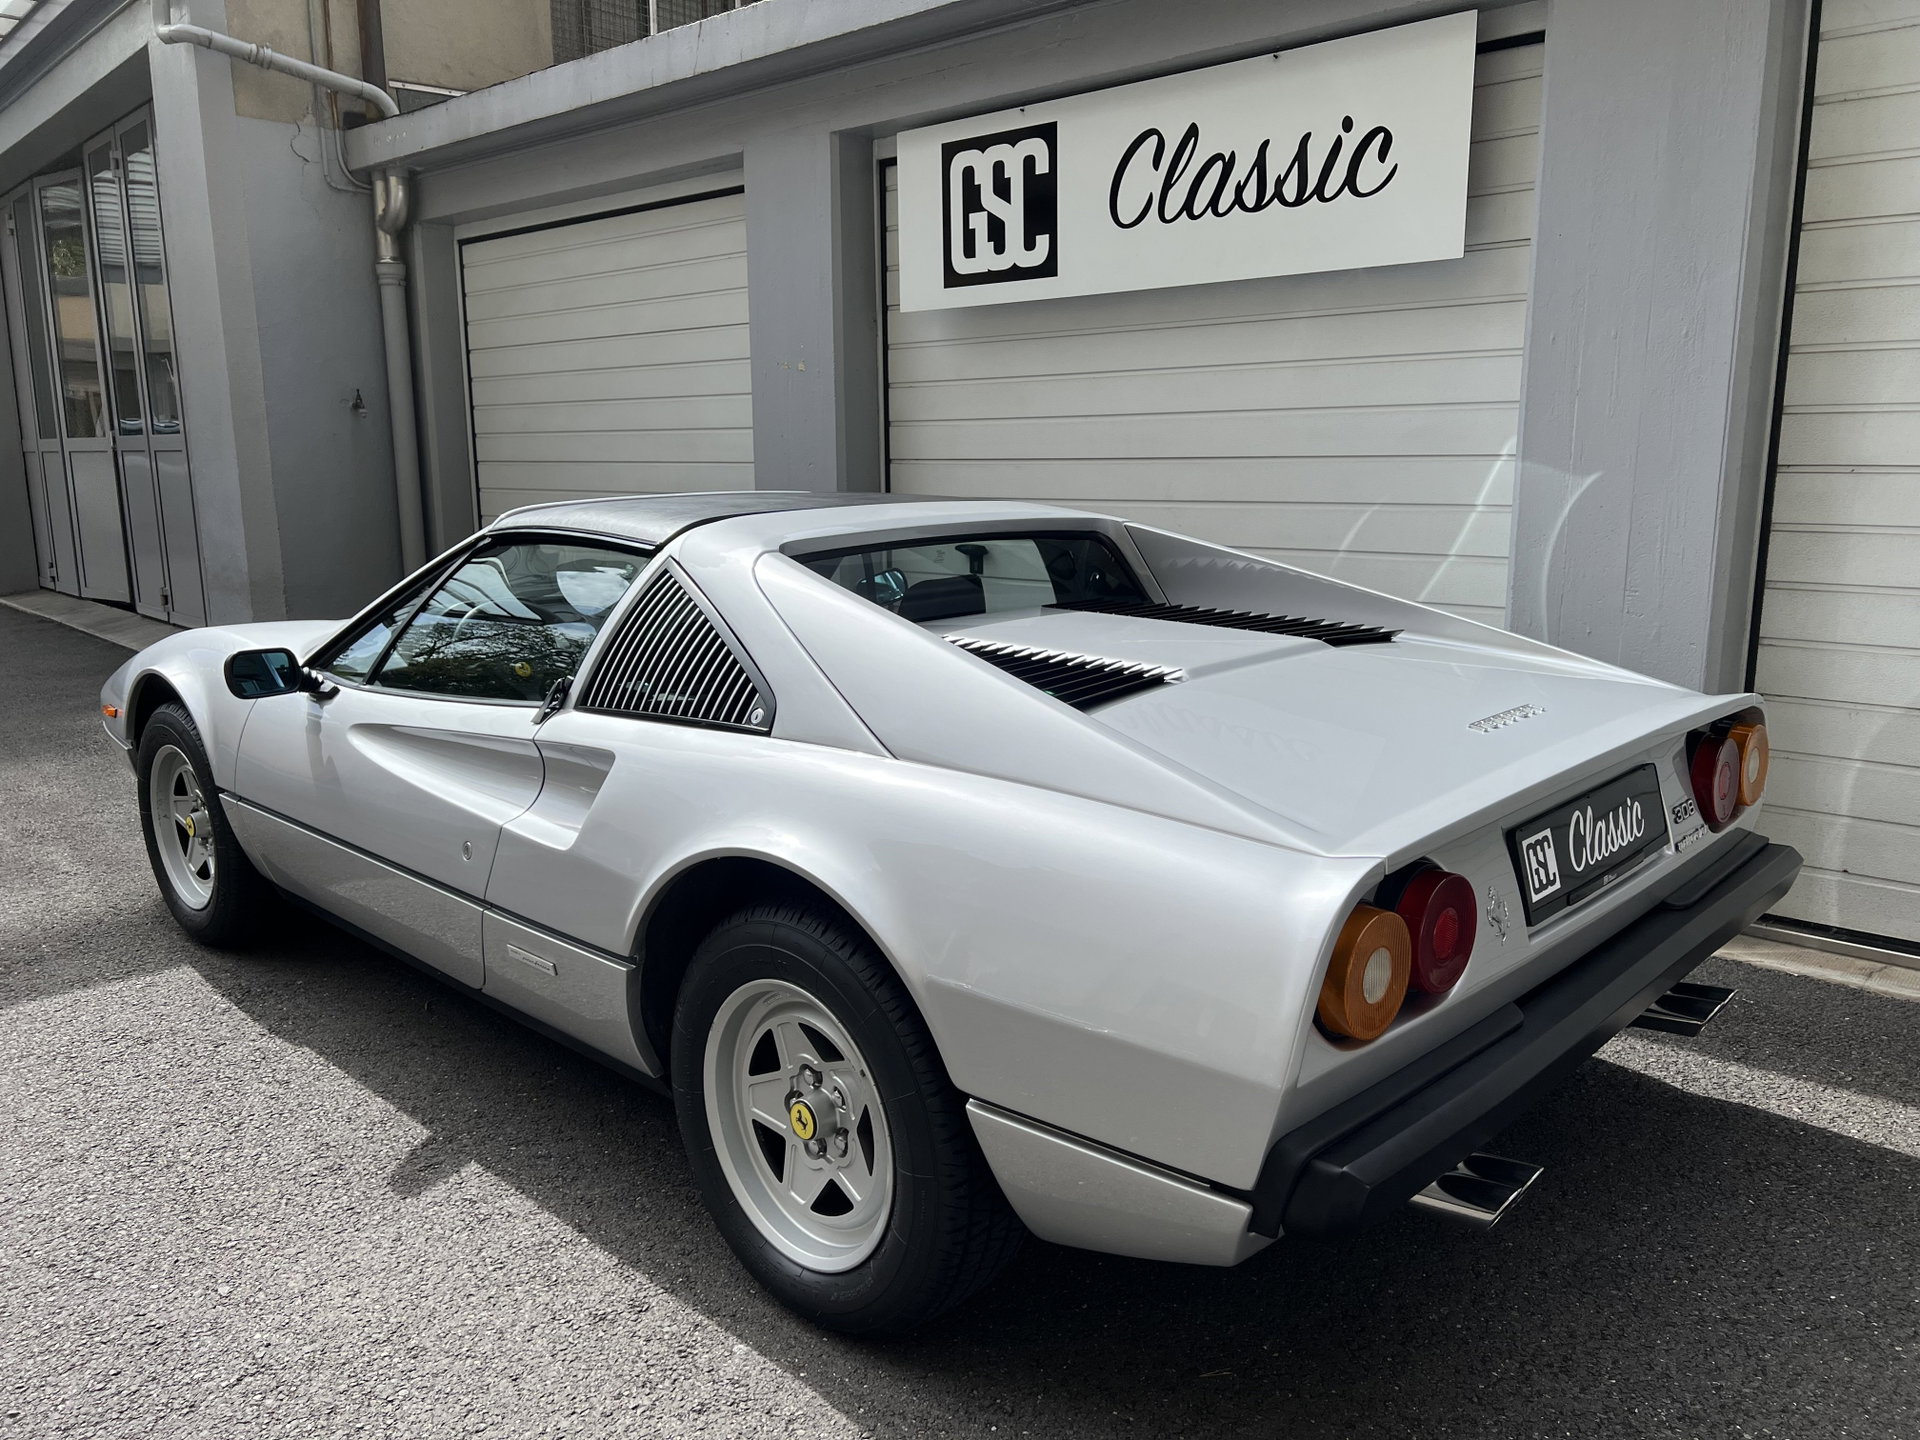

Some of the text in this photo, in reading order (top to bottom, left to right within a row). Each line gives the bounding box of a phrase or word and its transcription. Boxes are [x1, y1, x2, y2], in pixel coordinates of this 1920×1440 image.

[950, 115, 1398, 275] GSC Classic
[1526, 834, 1557, 896] GSC
[1569, 797, 1645, 872] Classic
[1672, 798, 1695, 824] 308
